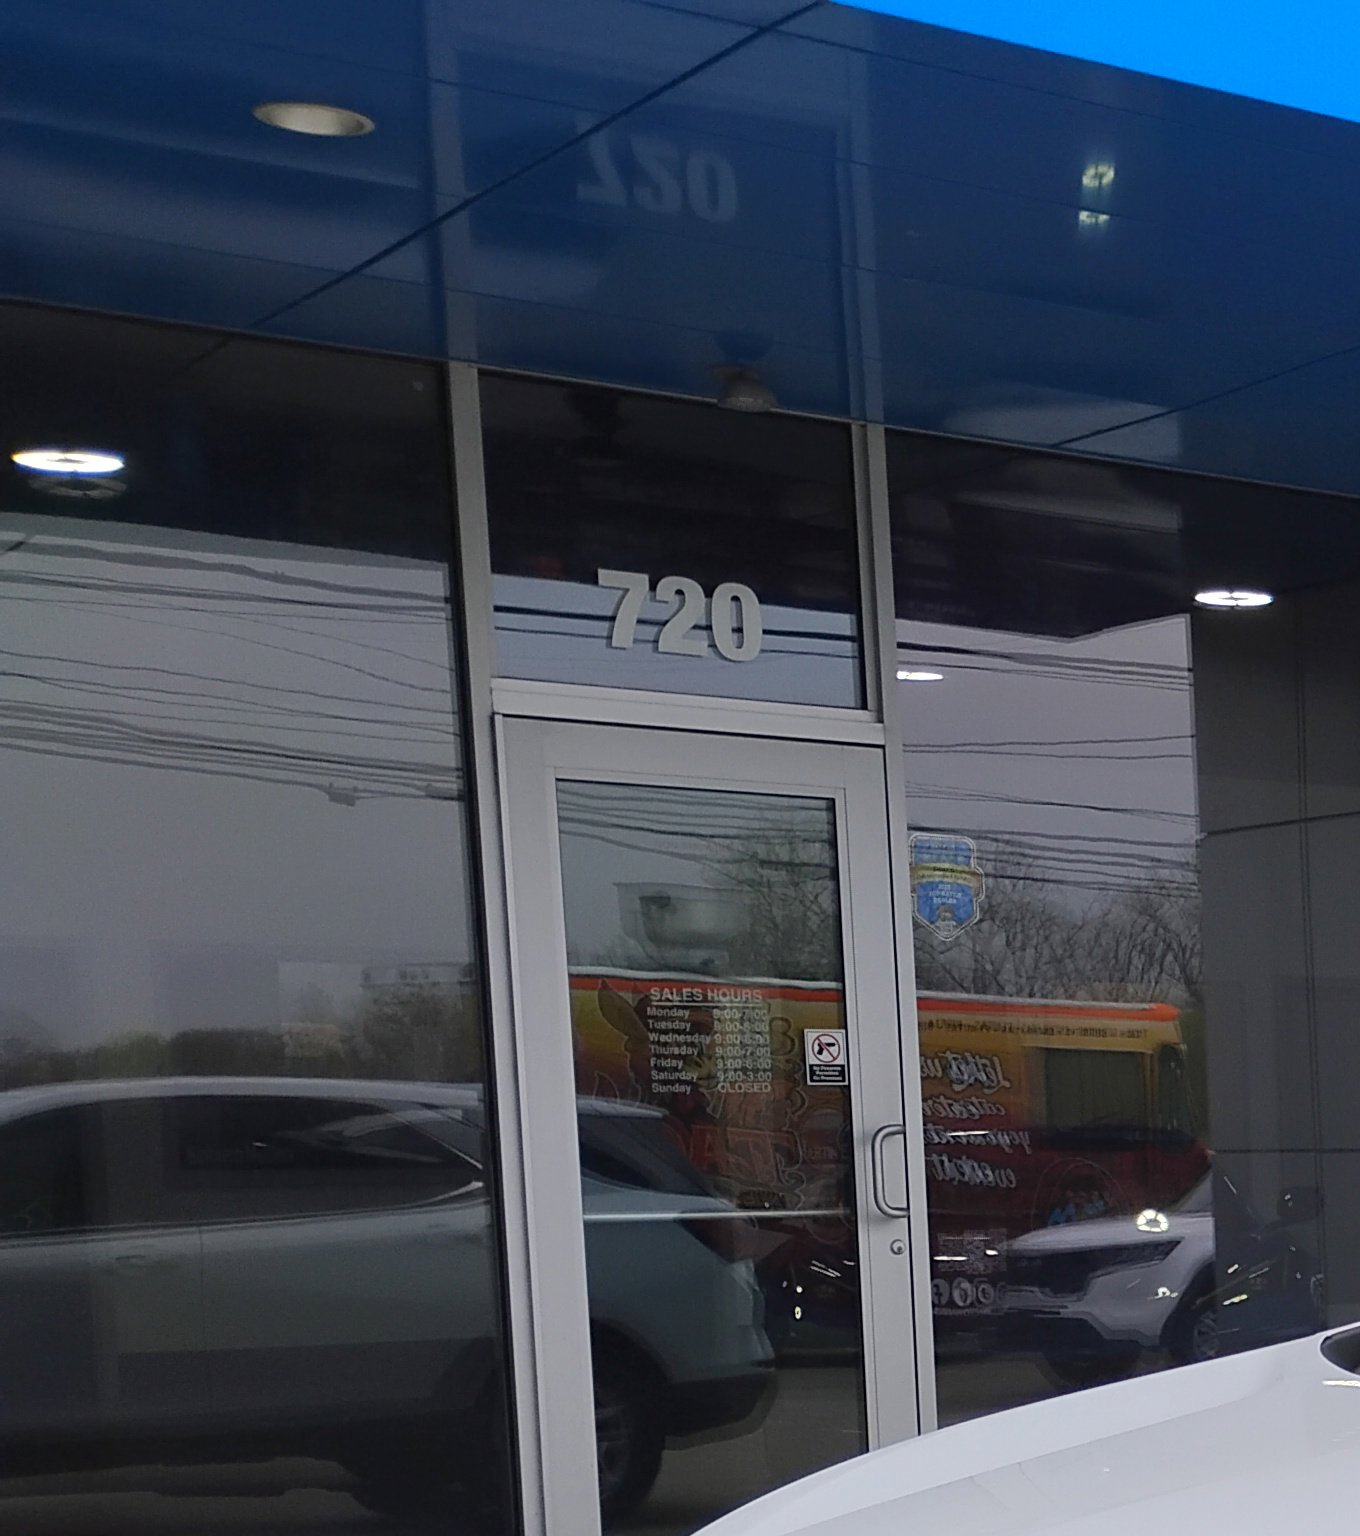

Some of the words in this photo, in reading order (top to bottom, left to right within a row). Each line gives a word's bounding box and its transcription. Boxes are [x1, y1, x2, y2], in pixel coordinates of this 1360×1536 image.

[598, 568, 763, 662] 720
[650, 987, 703, 1001] SALES
[707, 988, 763, 1002] HOURS
[646, 1006, 690, 1019] Monday
[647, 1019, 692, 1032] Tuesday
[647, 1032, 712, 1044] Wednesday
[648, 1044, 699, 1057] Thursday
[650, 1057, 684, 1069] Friday
[651, 1070, 699, 1082] Saturday
[717, 1070, 773, 1081] 9:00-3:00
[651, 1082, 692, 1095] Sunday
[717, 1082, 771, 1093] CLOSED
